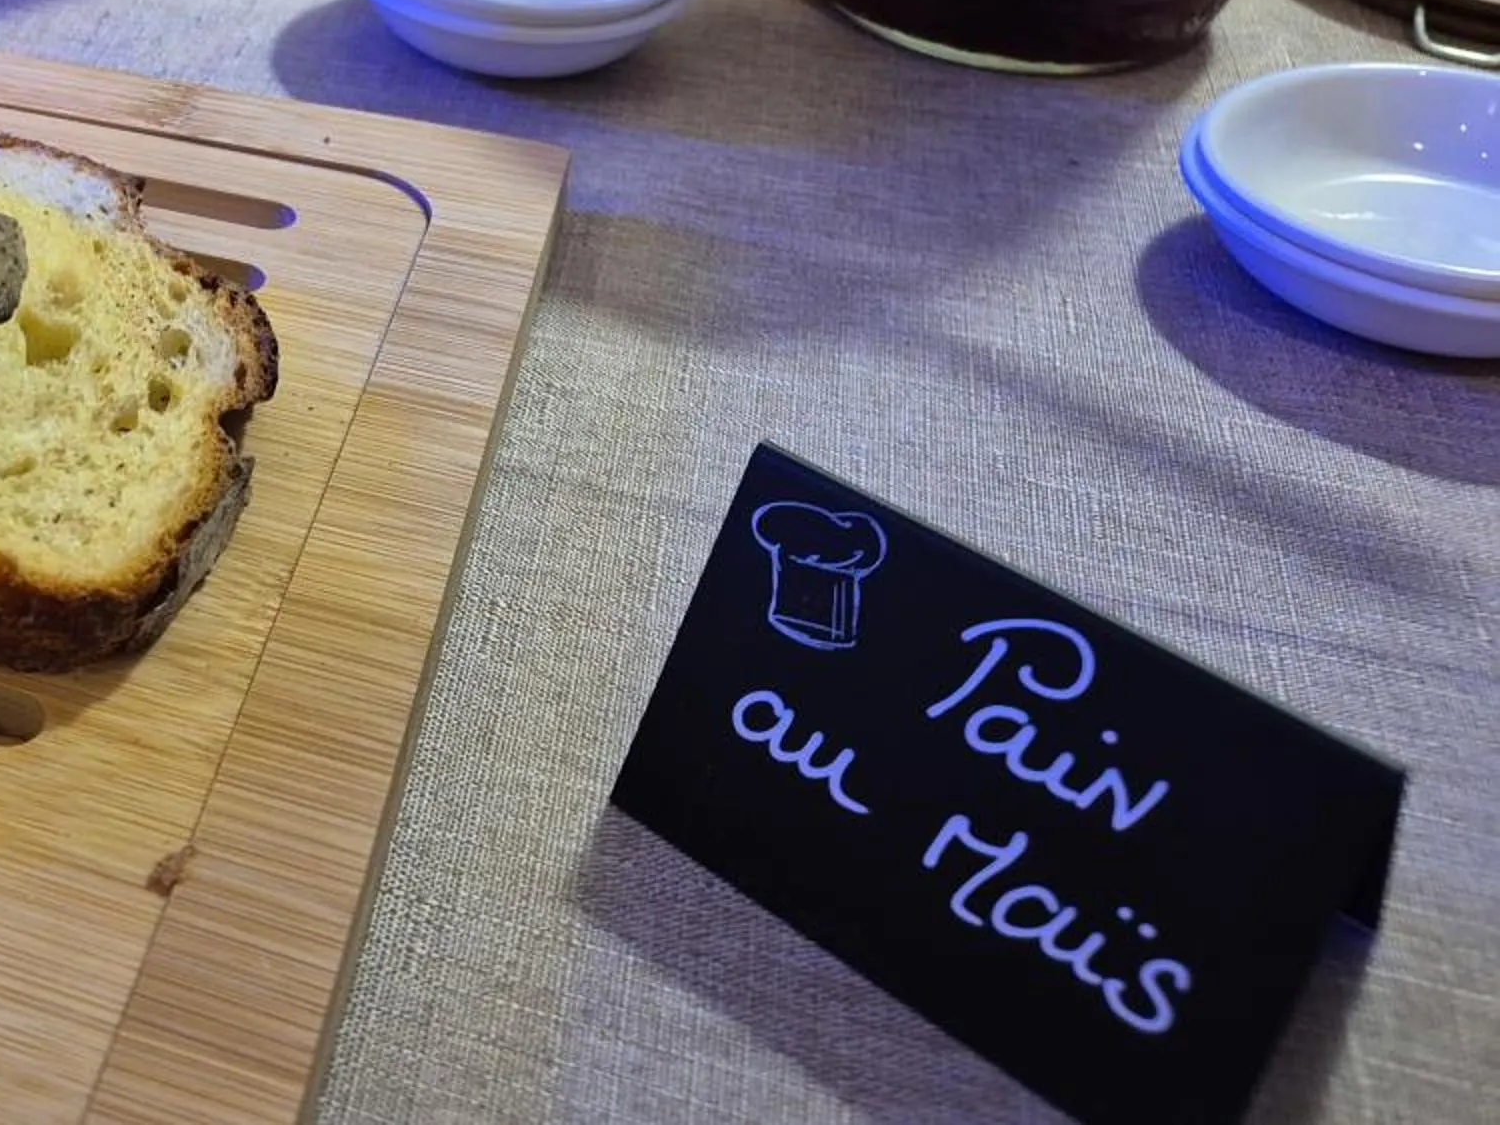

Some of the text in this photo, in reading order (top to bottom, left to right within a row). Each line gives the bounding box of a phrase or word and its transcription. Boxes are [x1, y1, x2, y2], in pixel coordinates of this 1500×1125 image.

[731, 689, 1192, 1035] au Maïs
[925, 617, 1171, 832] Pain
